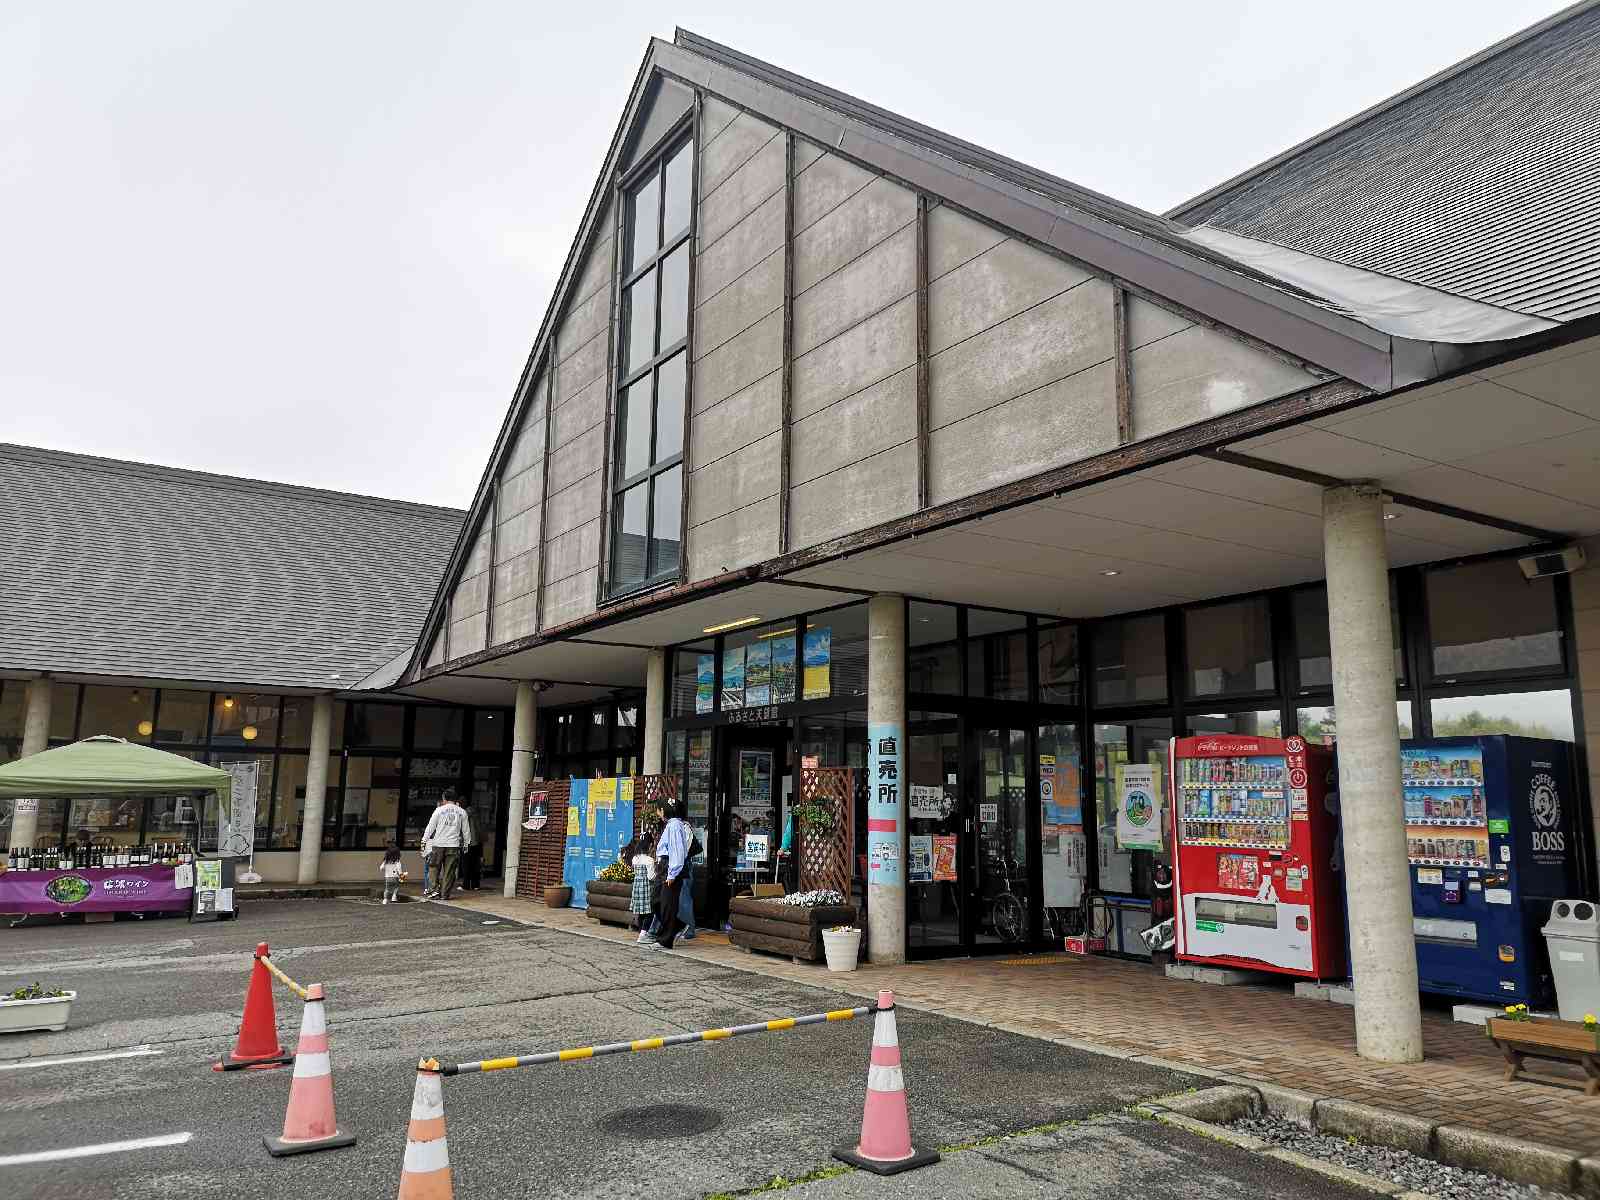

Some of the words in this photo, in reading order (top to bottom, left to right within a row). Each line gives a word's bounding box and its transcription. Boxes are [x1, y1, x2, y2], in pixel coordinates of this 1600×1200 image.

[878, 736, 898, 804] 直売所
[1532, 831, 1565, 851] BOSS
